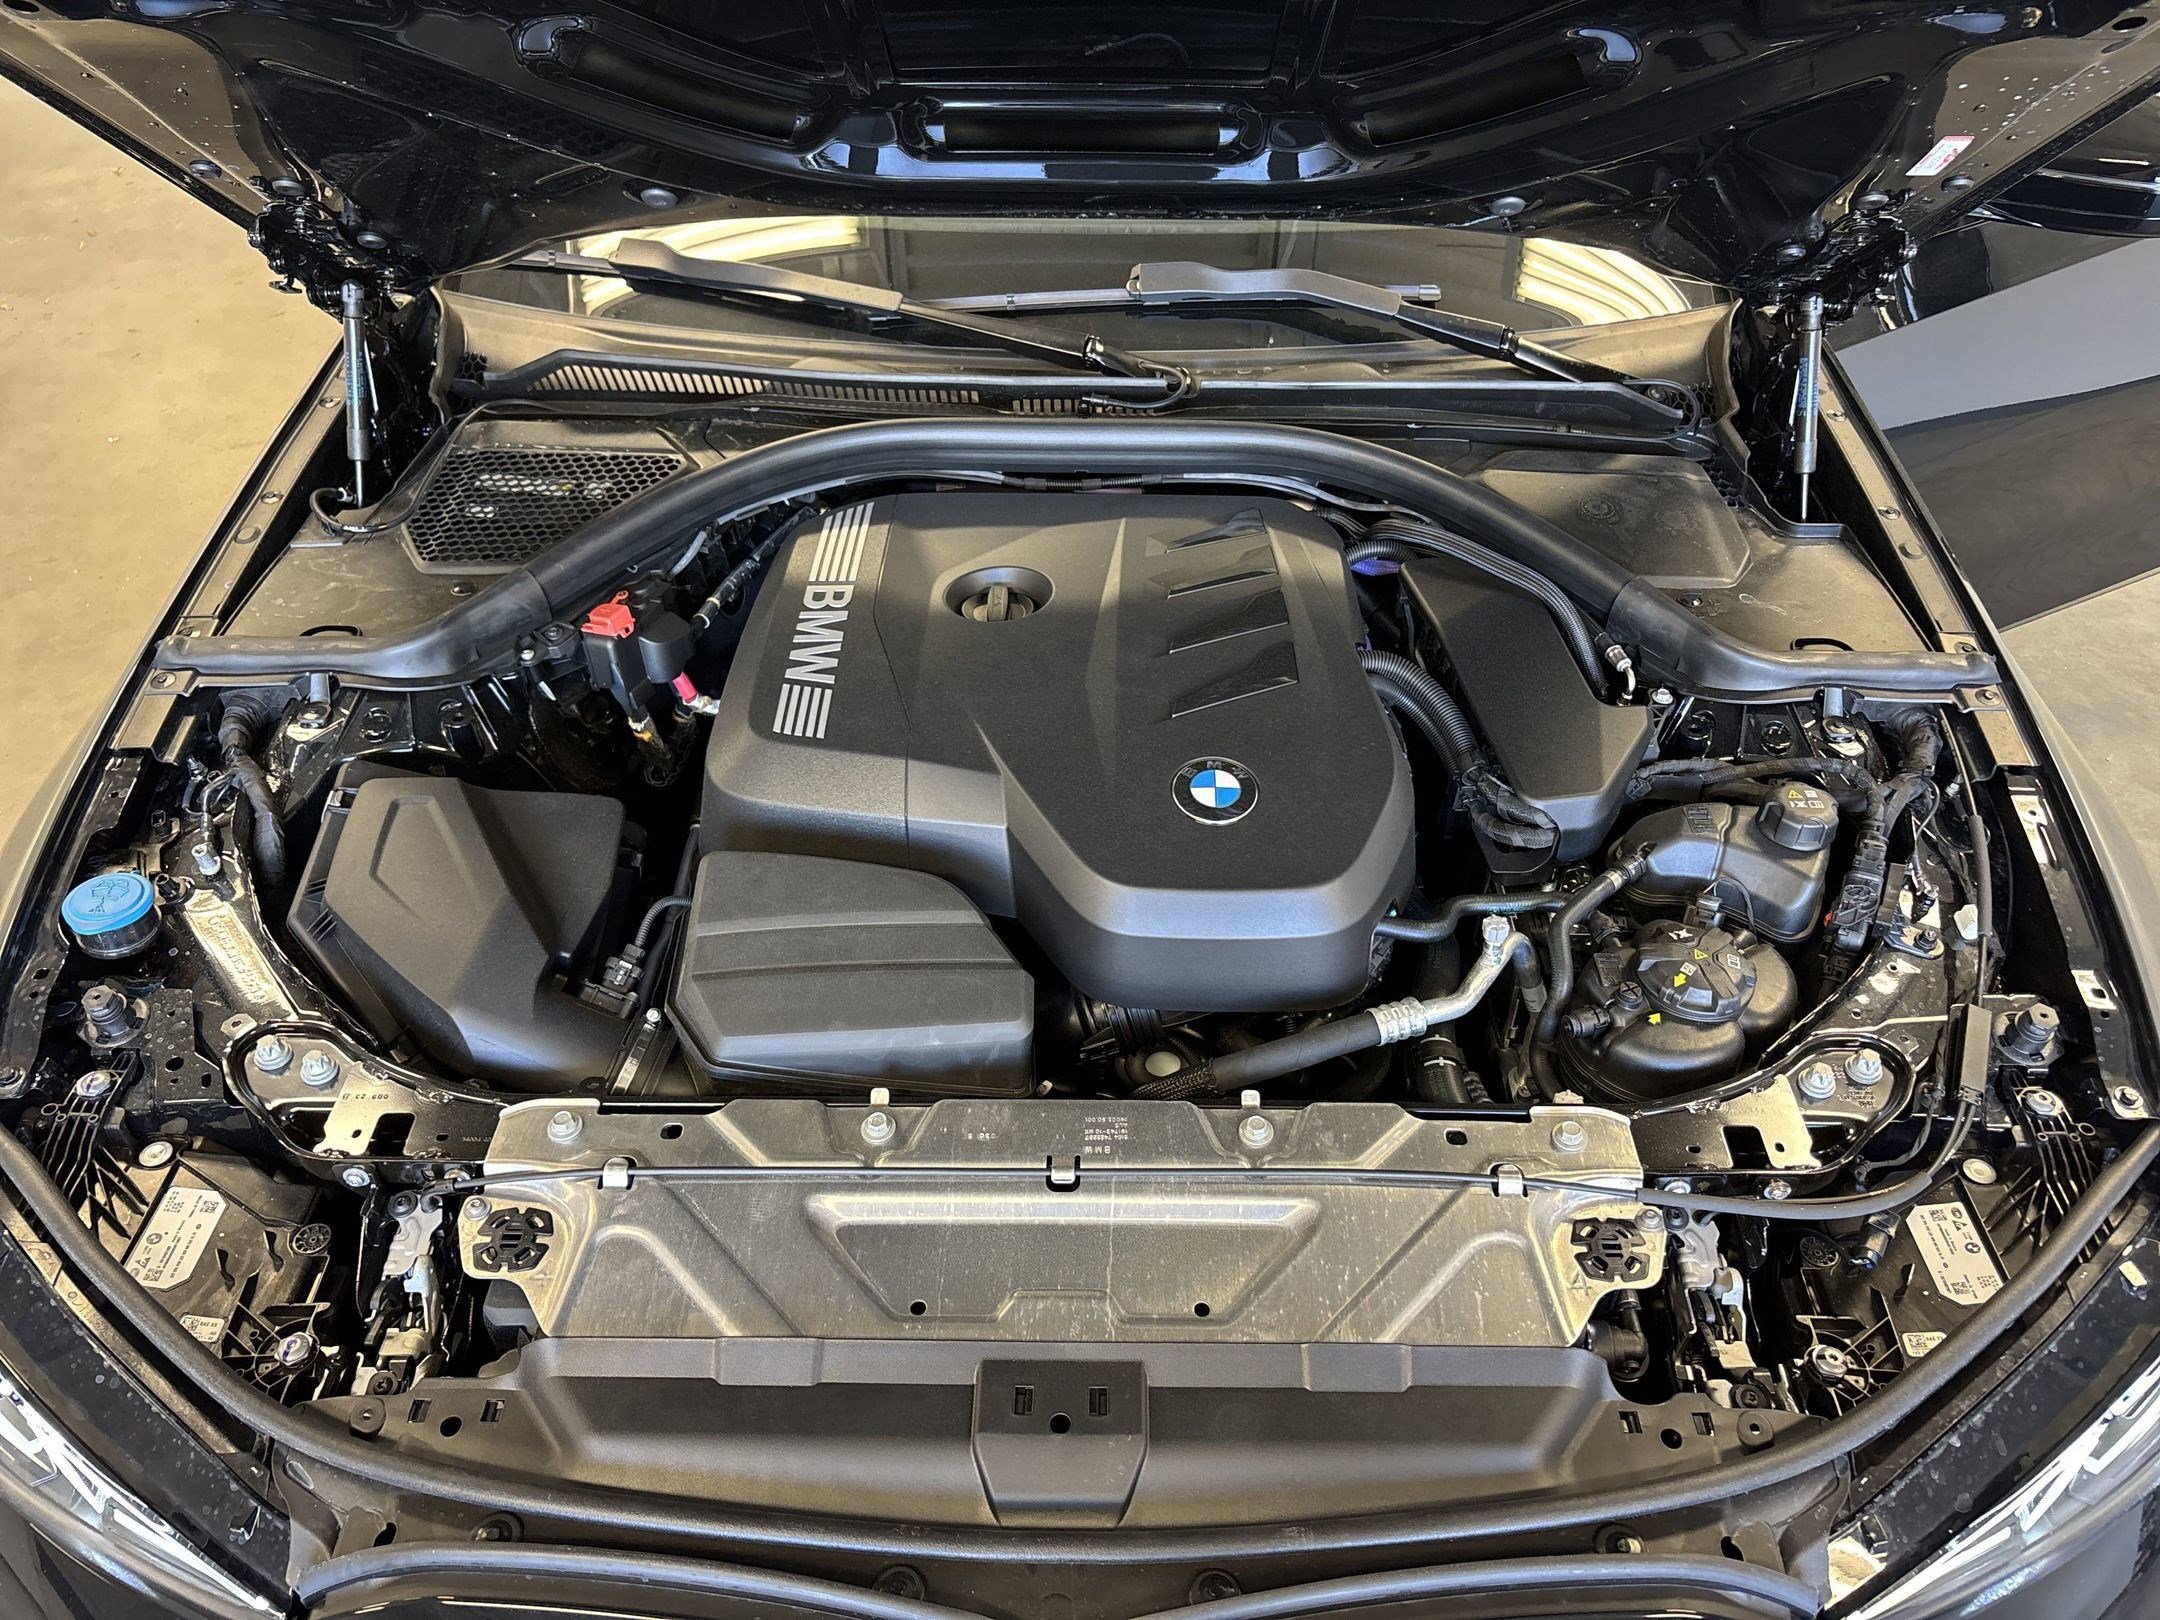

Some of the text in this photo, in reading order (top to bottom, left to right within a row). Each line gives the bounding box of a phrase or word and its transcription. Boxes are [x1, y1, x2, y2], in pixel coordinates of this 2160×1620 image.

[784, 584, 855, 685] BMW
[1181, 760, 1249, 779] BMW
[1084, 1146, 1111, 1154] BMW
